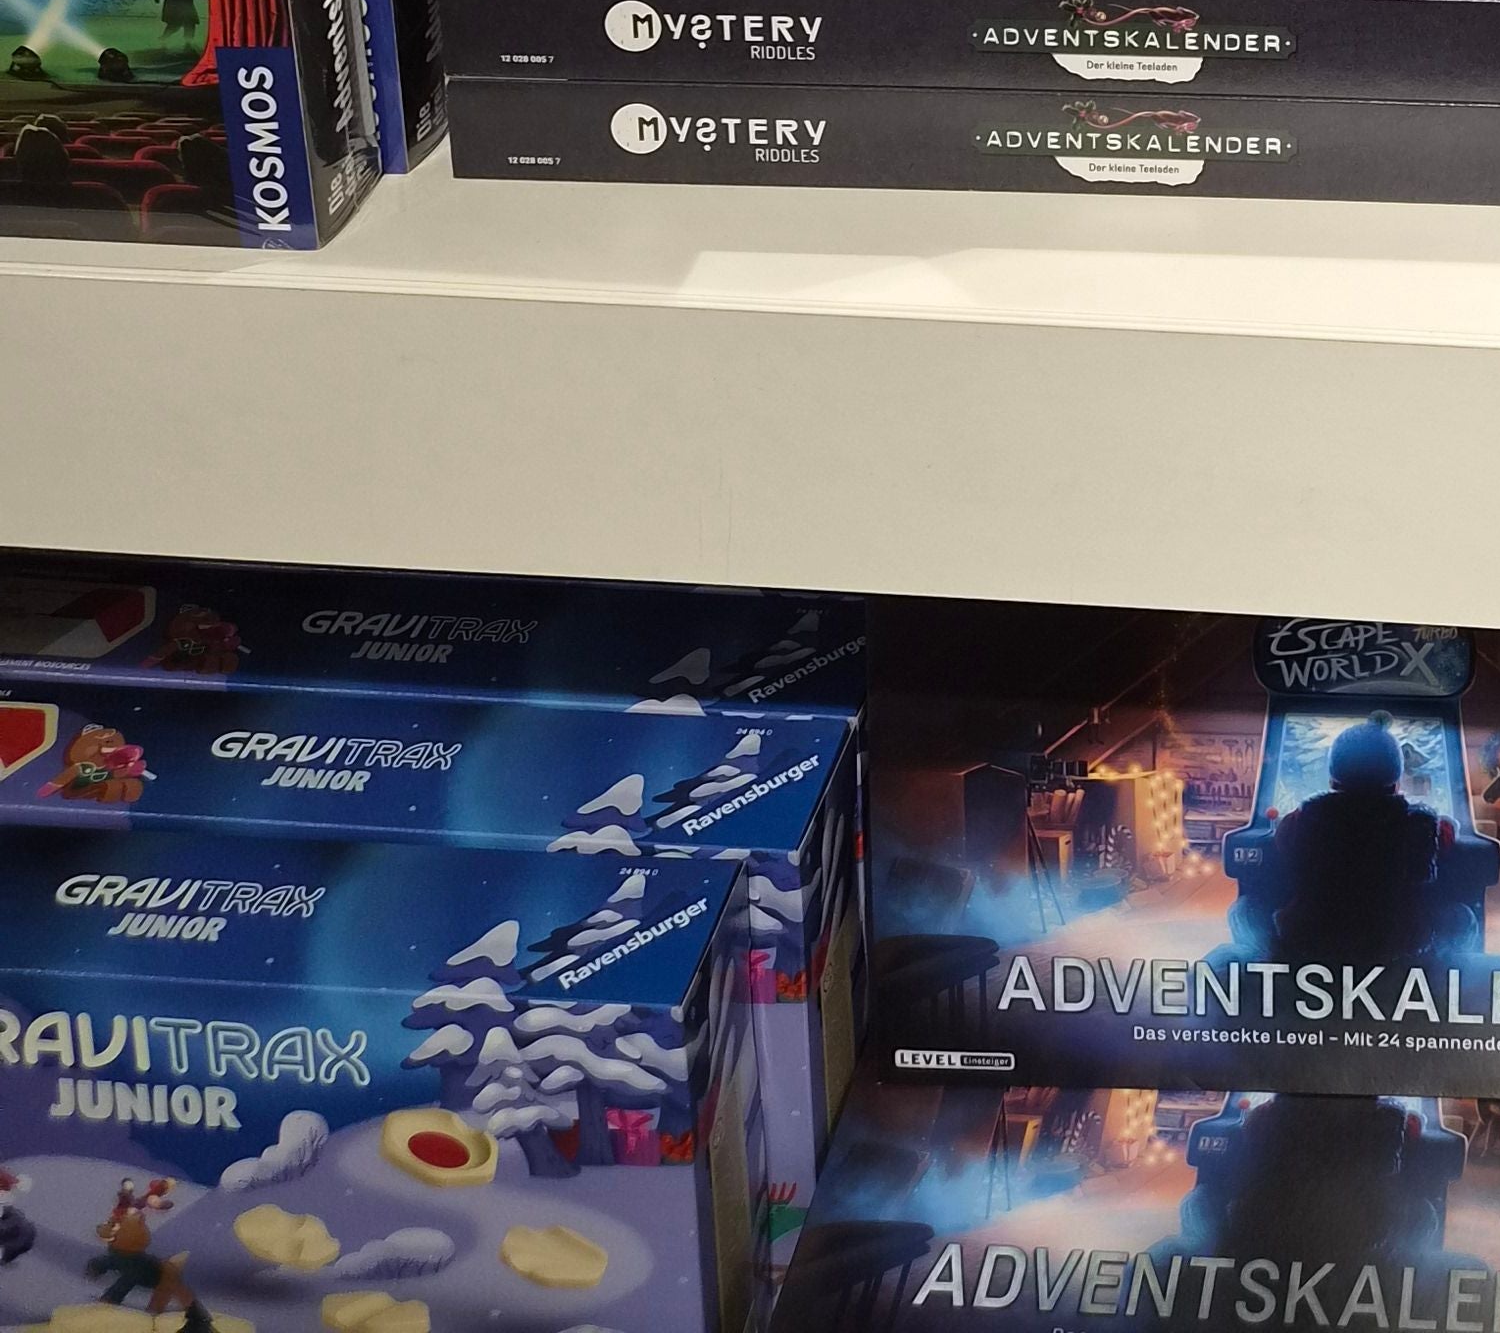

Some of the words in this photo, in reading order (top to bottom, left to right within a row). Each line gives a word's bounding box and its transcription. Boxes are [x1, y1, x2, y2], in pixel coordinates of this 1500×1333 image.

[620, 6, 822, 51] MYSTERY
[983, 25, 1281, 53] ADVENTSKALENDER
[750, 44, 816, 61] RIDDLES
[1086, 59, 1105, 72] Der
[1107, 60, 1133, 72] kleine
[1135, 60, 1178, 73] Teeladen
[626, 109, 827, 153] MYSTERY
[987, 129, 1281, 156] ADVENTSKALENDER
[240, 65, 293, 234] KOSMOS
[755, 147, 820, 164] RIDDLES
[1267, 649, 1399, 688] WORLD
[210, 731, 462, 770] GRAVITRAX
[261, 766, 370, 794] JUNIOR
[682, 752, 823, 836] Ravensburger
[55, 874, 327, 917] GRAVITRAX
[108, 912, 225, 943] JUNIOR
[557, 896, 711, 991] Ravensburger
[1133, 1026, 1167, 1042] Das
[1172, 1027, 1272, 1044] versteckte
[1276, 1028, 1324, 1046] Level
[1343, 1030, 1373, 1047] Mit
[1377, 1033, 1401, 1048] 24
[899, 1052, 957, 1067] LEVEL
[963, 1055, 1010, 1067] Einsteiger
[50, 1078, 242, 1131] JUNIOR
